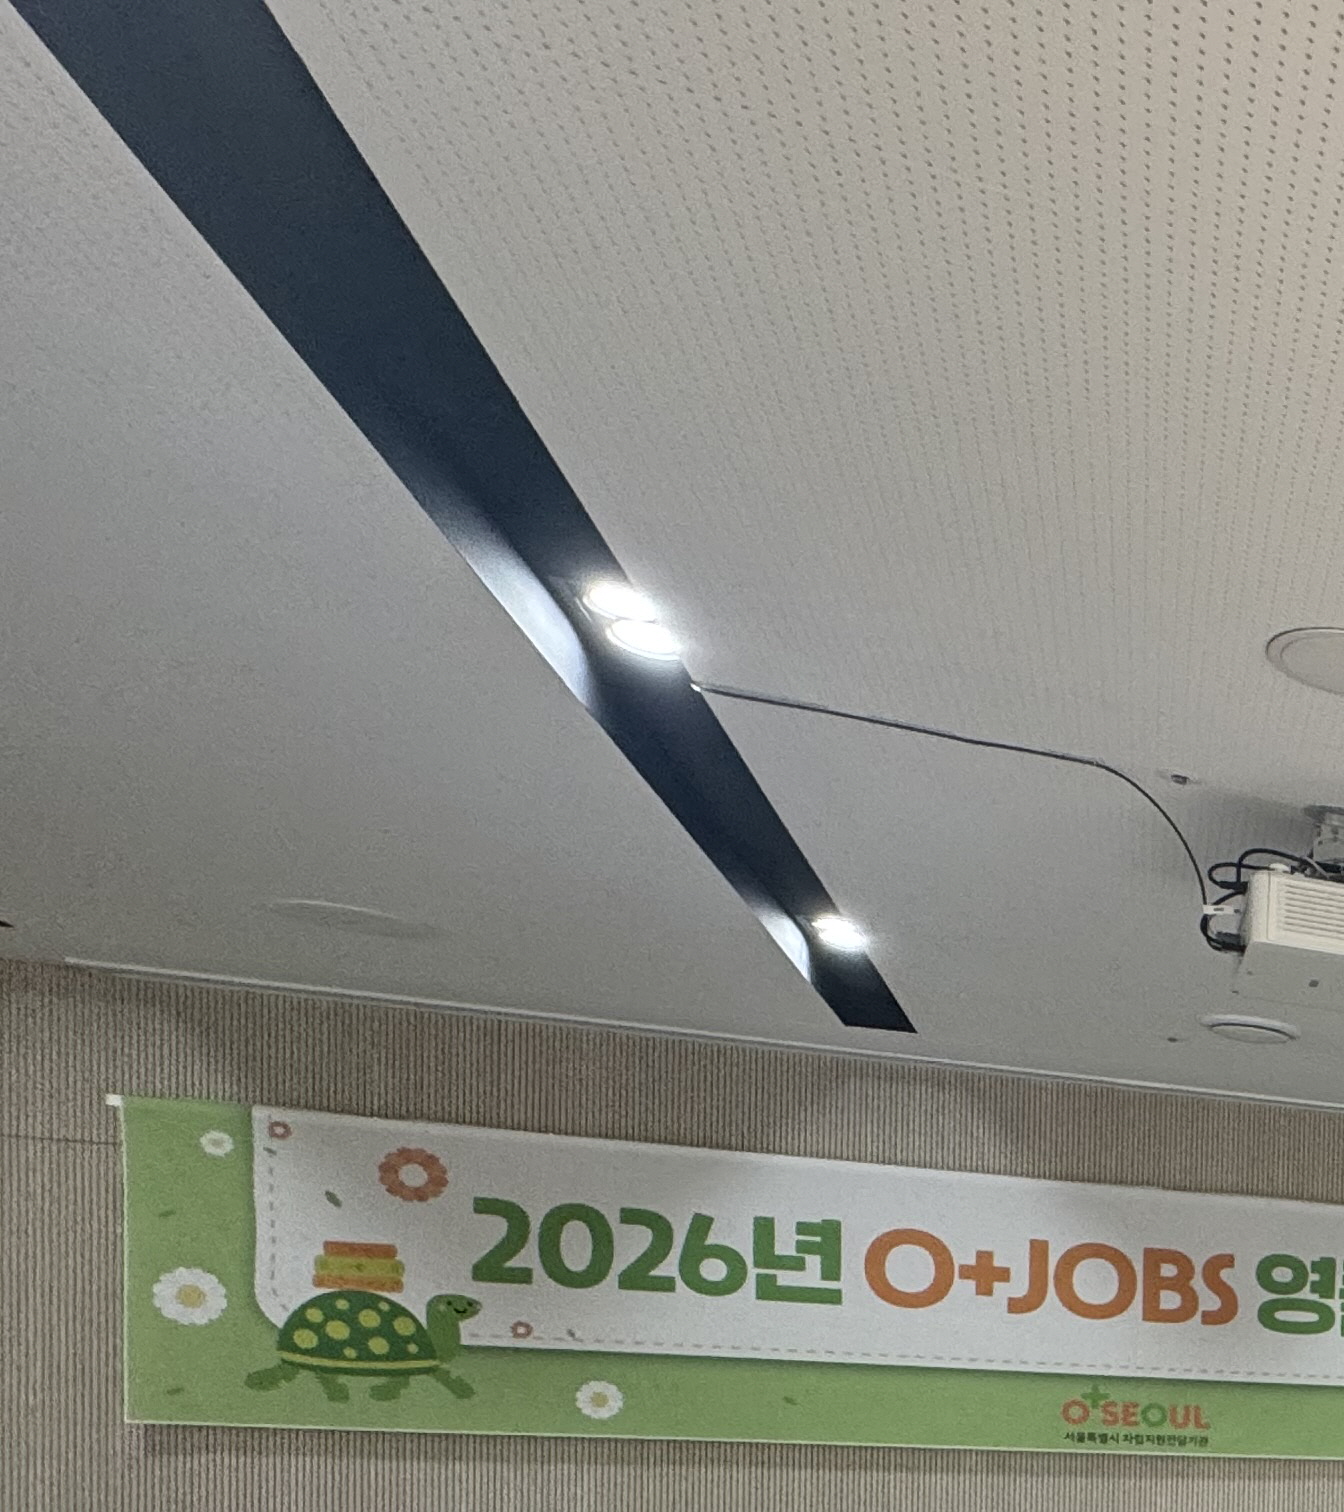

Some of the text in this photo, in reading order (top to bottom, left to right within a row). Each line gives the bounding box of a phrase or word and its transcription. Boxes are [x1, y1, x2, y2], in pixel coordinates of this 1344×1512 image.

[470, 1196, 843, 1306] 2026년
[863, 1227, 1239, 1327] O+JOBS
[1063, 1430, 1120, 1445] 서울특별시
